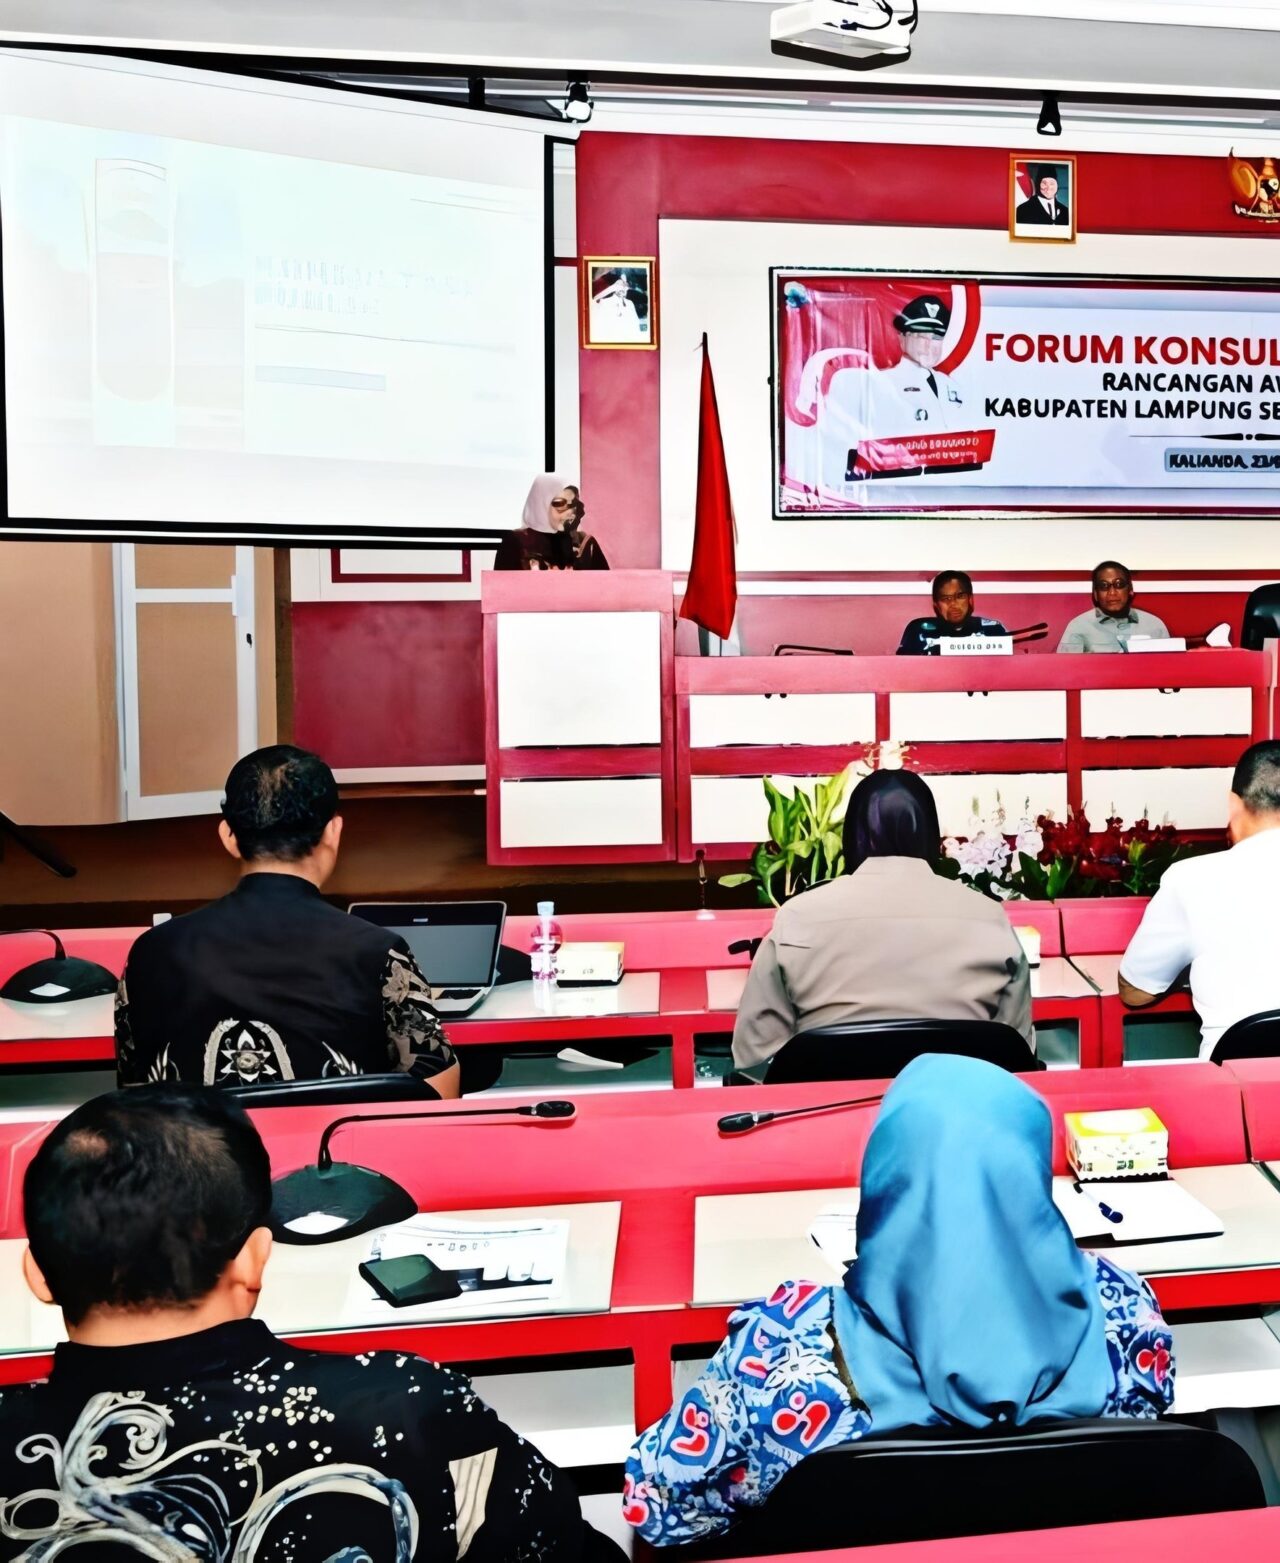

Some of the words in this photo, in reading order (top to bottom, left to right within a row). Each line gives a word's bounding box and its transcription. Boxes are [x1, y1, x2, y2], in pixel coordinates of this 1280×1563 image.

[985, 333, 1123, 364] FORUM
[1102, 372, 1253, 393] RANCANGAN
[985, 398, 1127, 418] KABUPATEN
[1135, 399, 1251, 420] LAMPUNG
